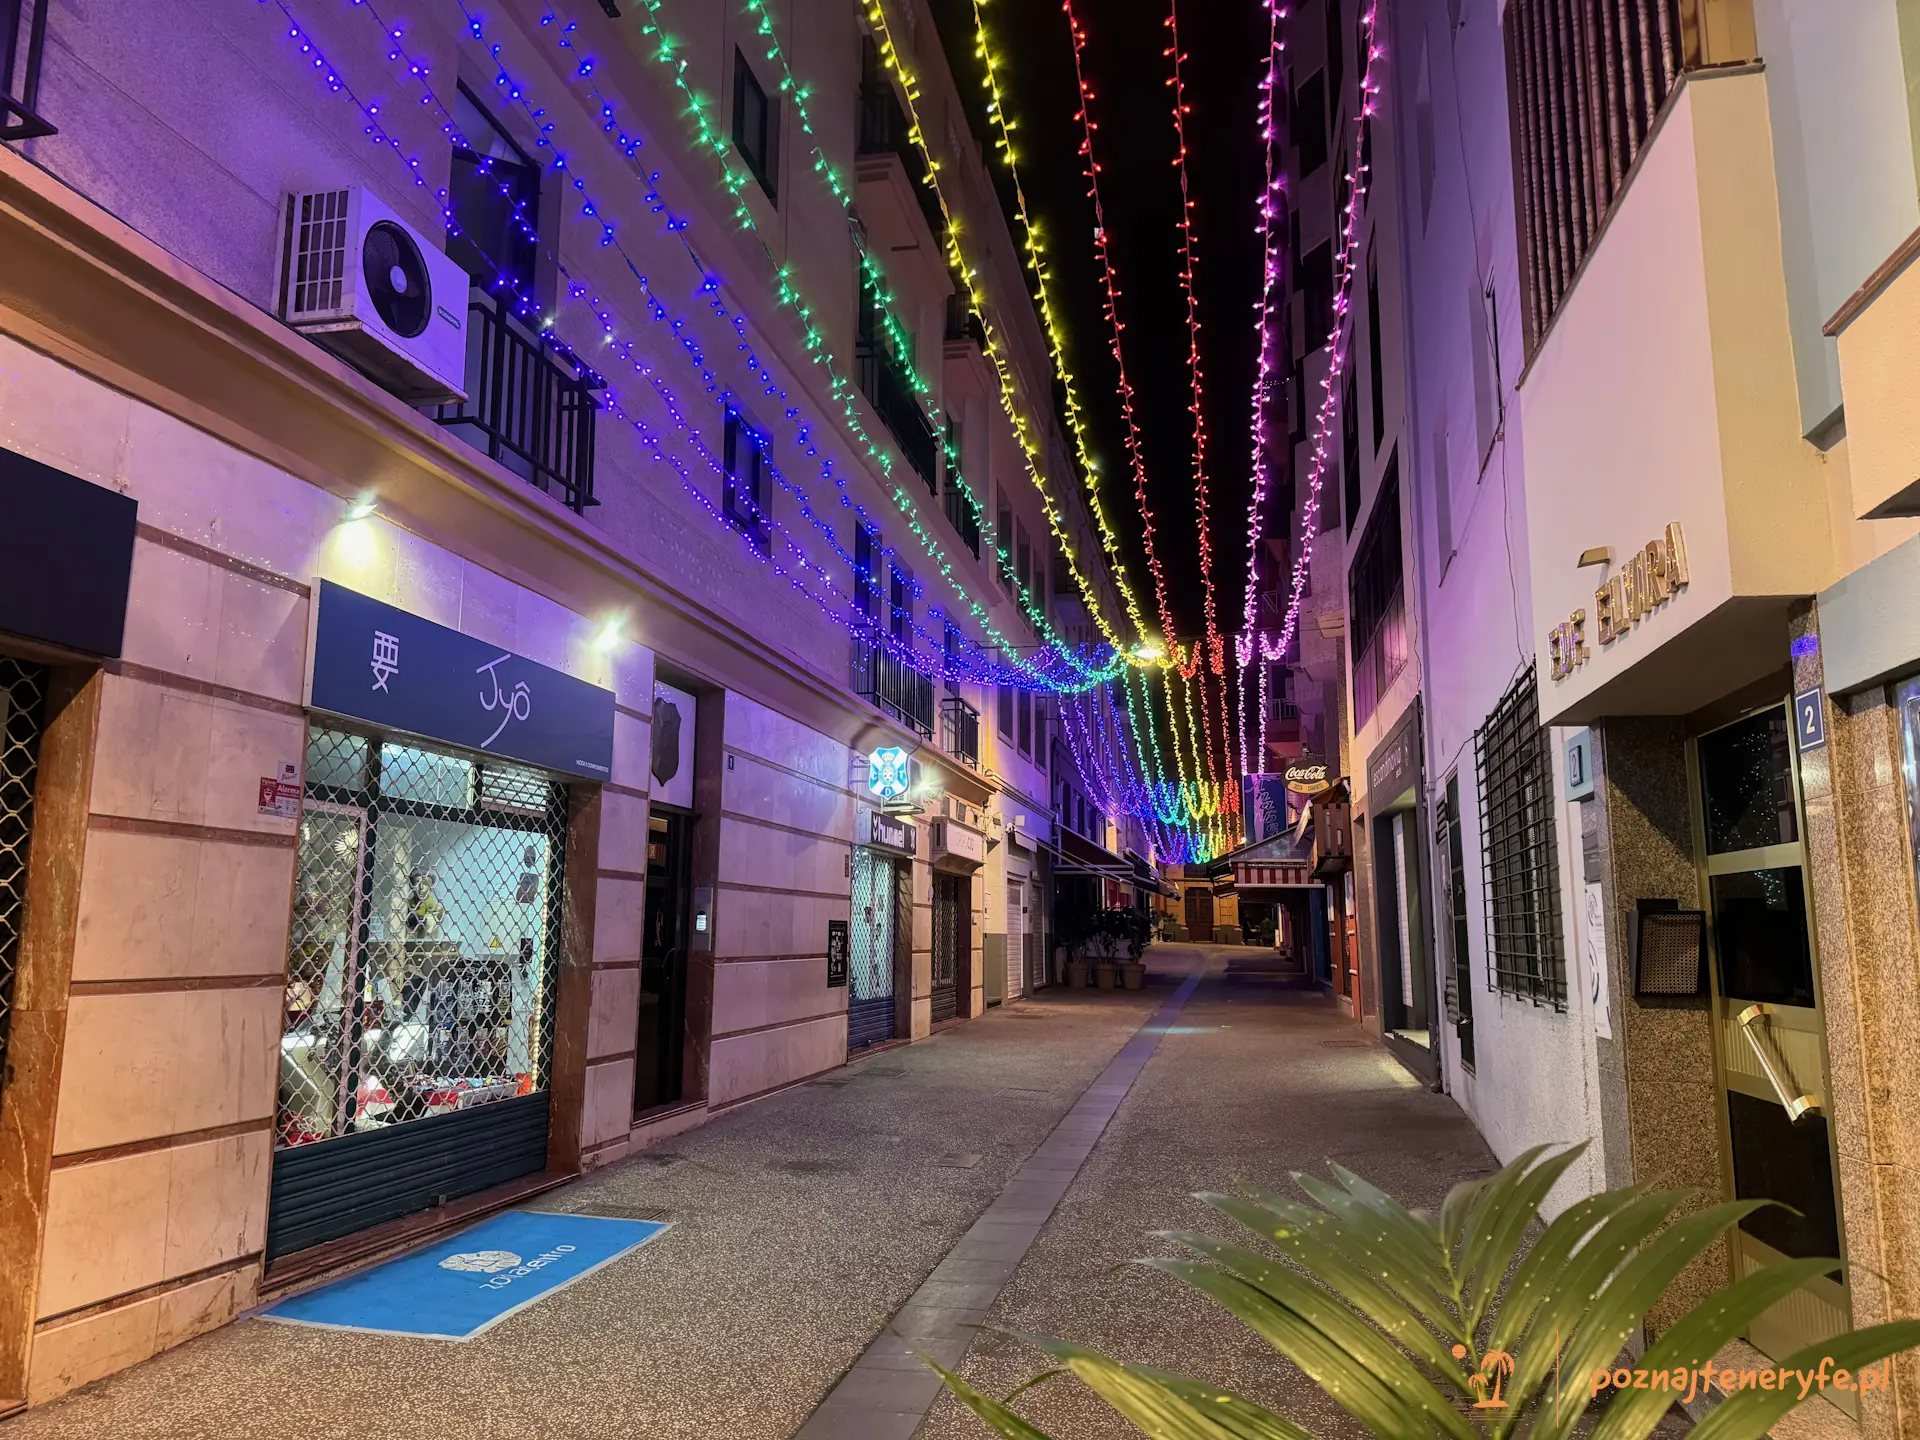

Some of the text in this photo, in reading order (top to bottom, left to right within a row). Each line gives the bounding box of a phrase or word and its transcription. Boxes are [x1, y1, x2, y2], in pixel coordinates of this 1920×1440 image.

[1595, 521, 1690, 645] ELVIRA
[370, 630, 399, 695] 要
[476, 653, 531, 749] Jyô
[1804, 705, 1816, 735] 2
[1285, 765, 1328, 780] Coca-Cola
[1571, 753, 1578, 779] 2
[277, 784, 300, 795] Alarma
